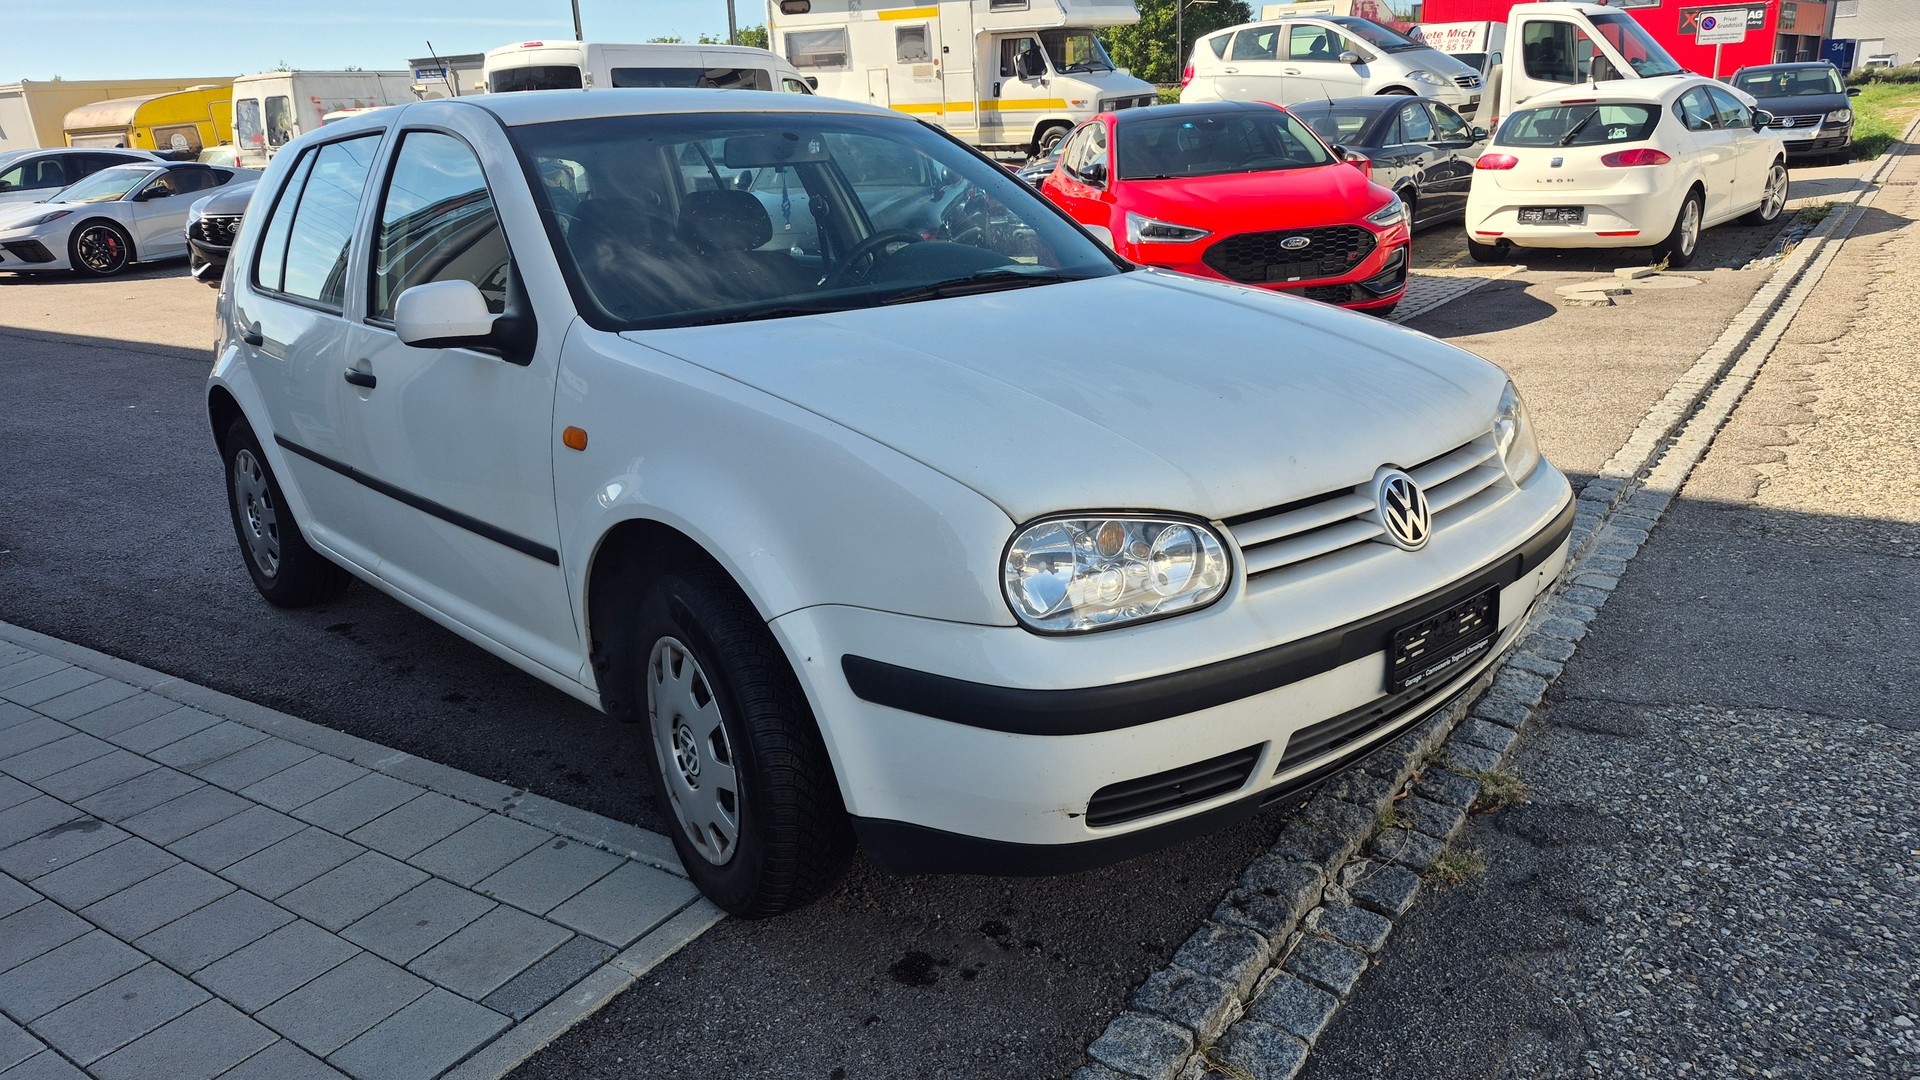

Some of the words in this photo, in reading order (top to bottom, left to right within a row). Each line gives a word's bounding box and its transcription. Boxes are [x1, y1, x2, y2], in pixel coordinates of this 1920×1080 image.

[1747, 10, 1764, 19] AG
[1447, 29, 1475, 38] Mich
[1831, 42, 1844, 51] 34
[1405, 674, 1422, 687] Garage
